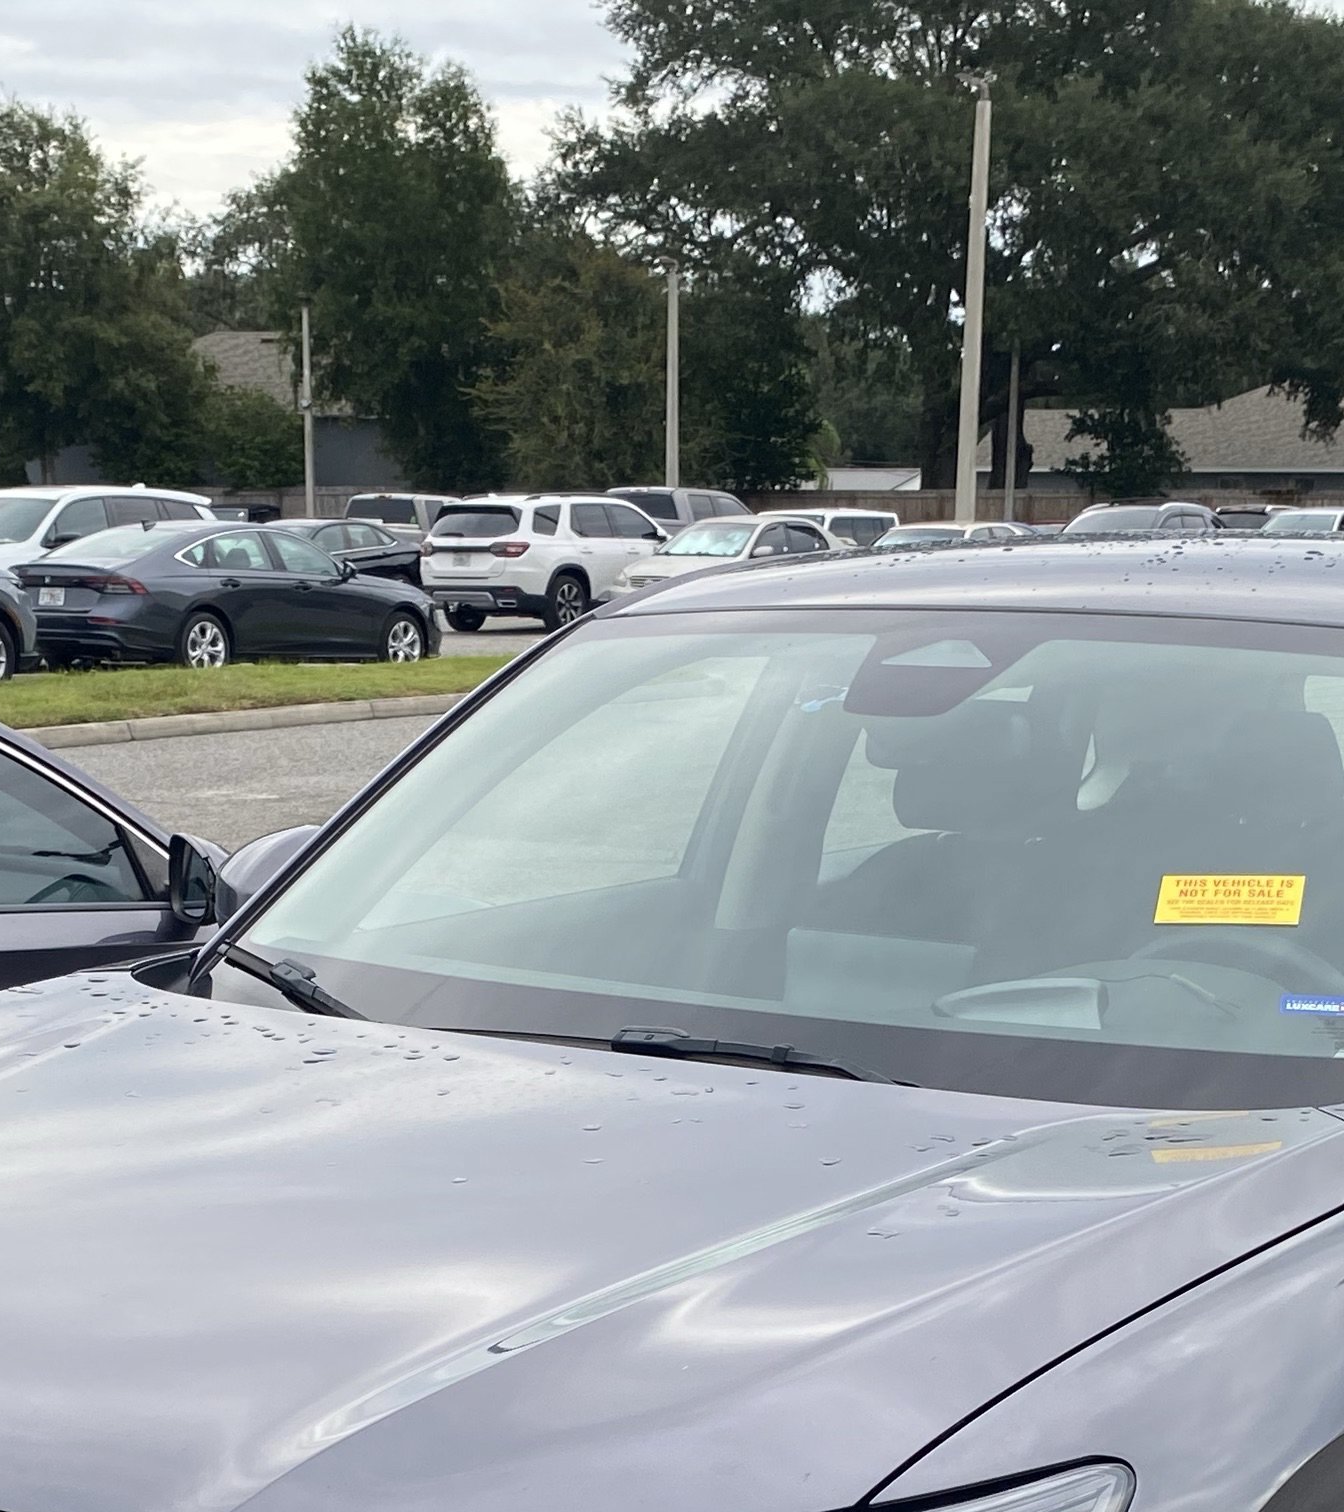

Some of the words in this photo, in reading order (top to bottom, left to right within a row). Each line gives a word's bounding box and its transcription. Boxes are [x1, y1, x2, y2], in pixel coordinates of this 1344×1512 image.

[1174, 879, 1208, 888] THIS
[1213, 879, 1274, 888] VEHICLE
[1280, 879, 1296, 888] IS
[1178, 889, 1208, 898] NOT
[1213, 889, 1242, 898] FOR
[1247, 889, 1285, 898] SALE
[1285, 1002, 1340, 1012] LUXCARE
